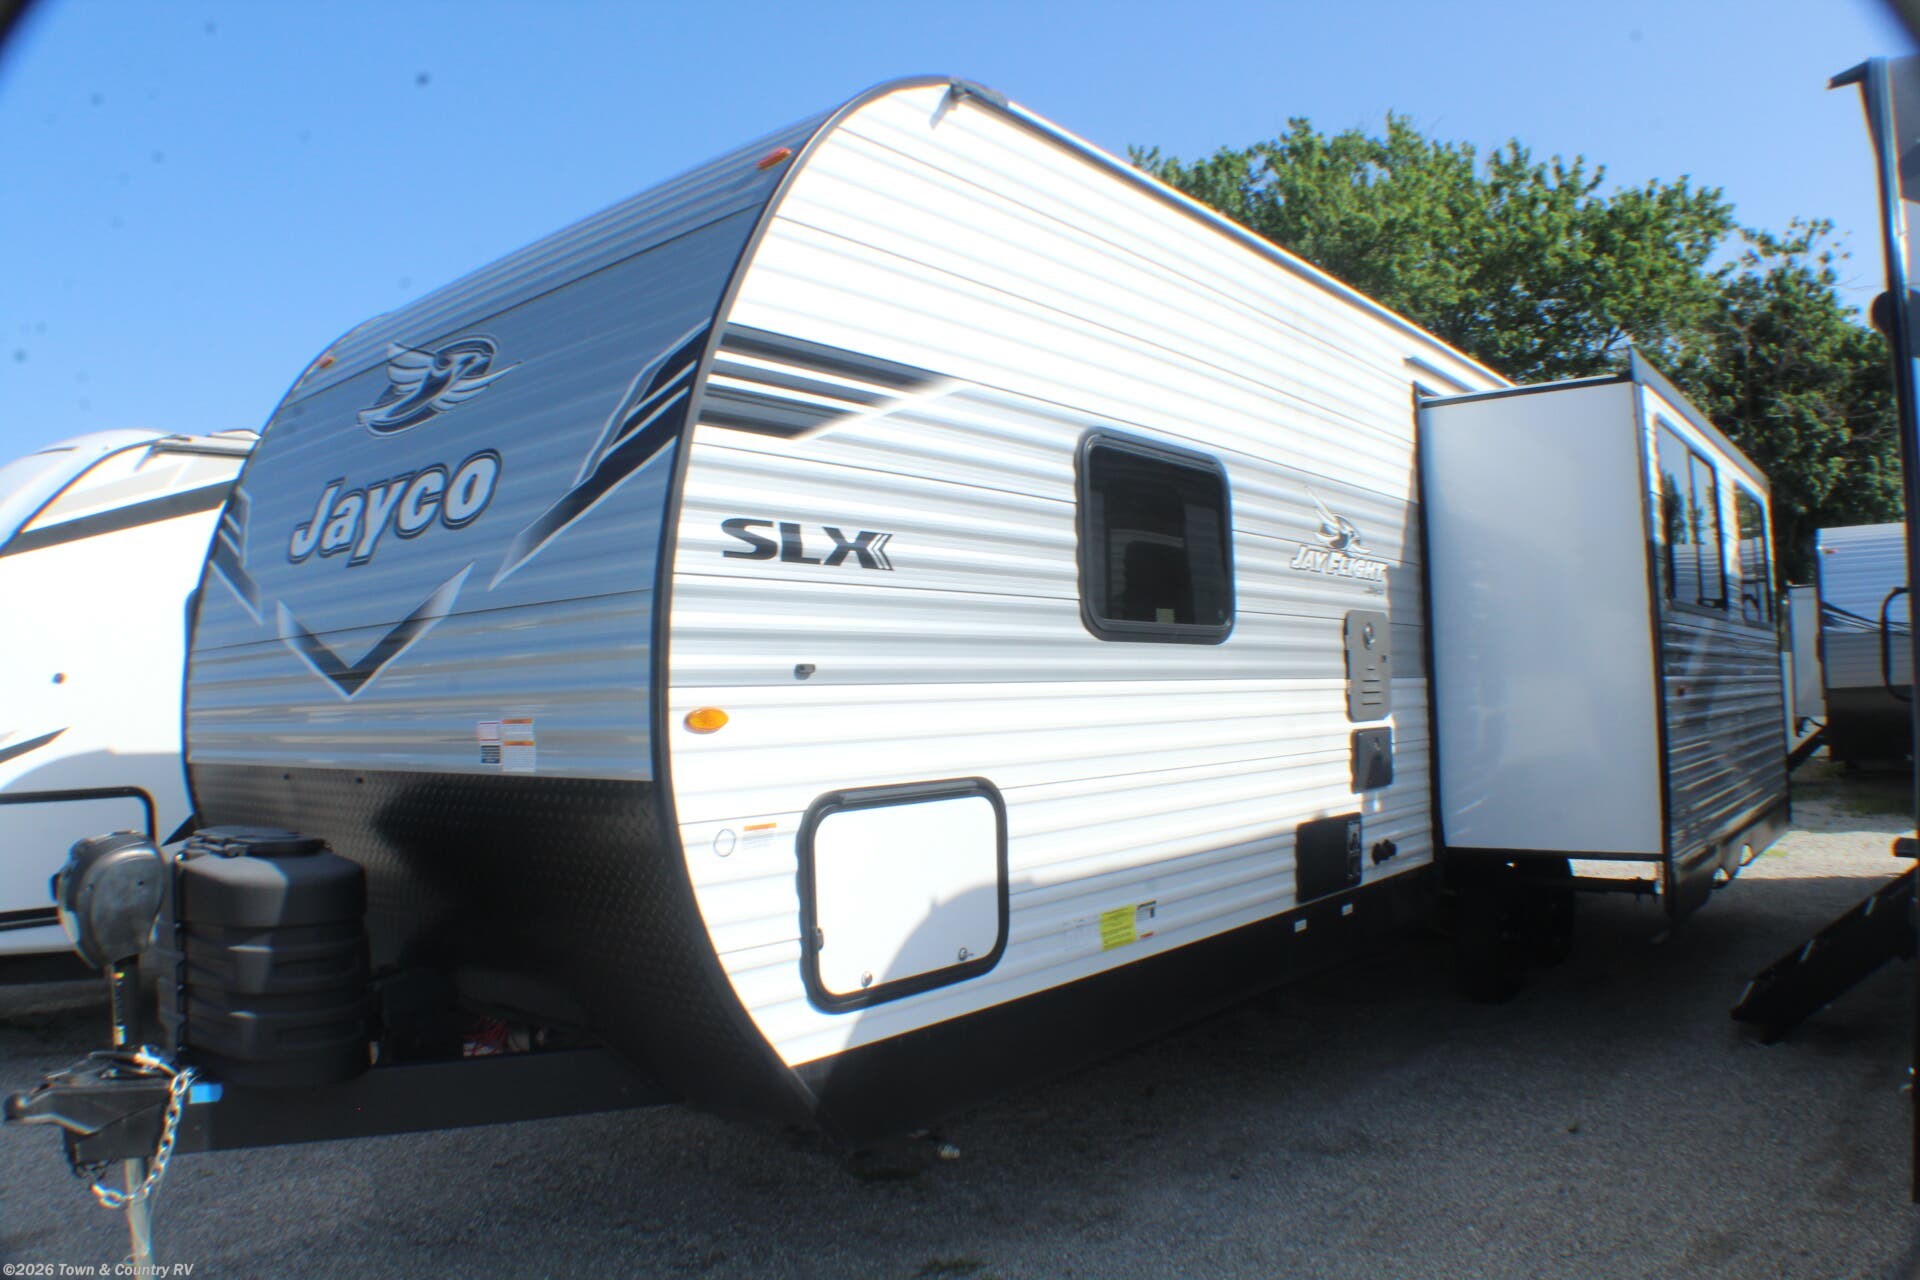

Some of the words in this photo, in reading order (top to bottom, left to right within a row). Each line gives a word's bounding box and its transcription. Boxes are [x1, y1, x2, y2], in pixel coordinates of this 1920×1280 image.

[288, 448, 502, 568] Jayco
[721, 517, 894, 571] SLX
[1289, 545, 1330, 573] JAY
[1325, 551, 1388, 583] FLIGHT
